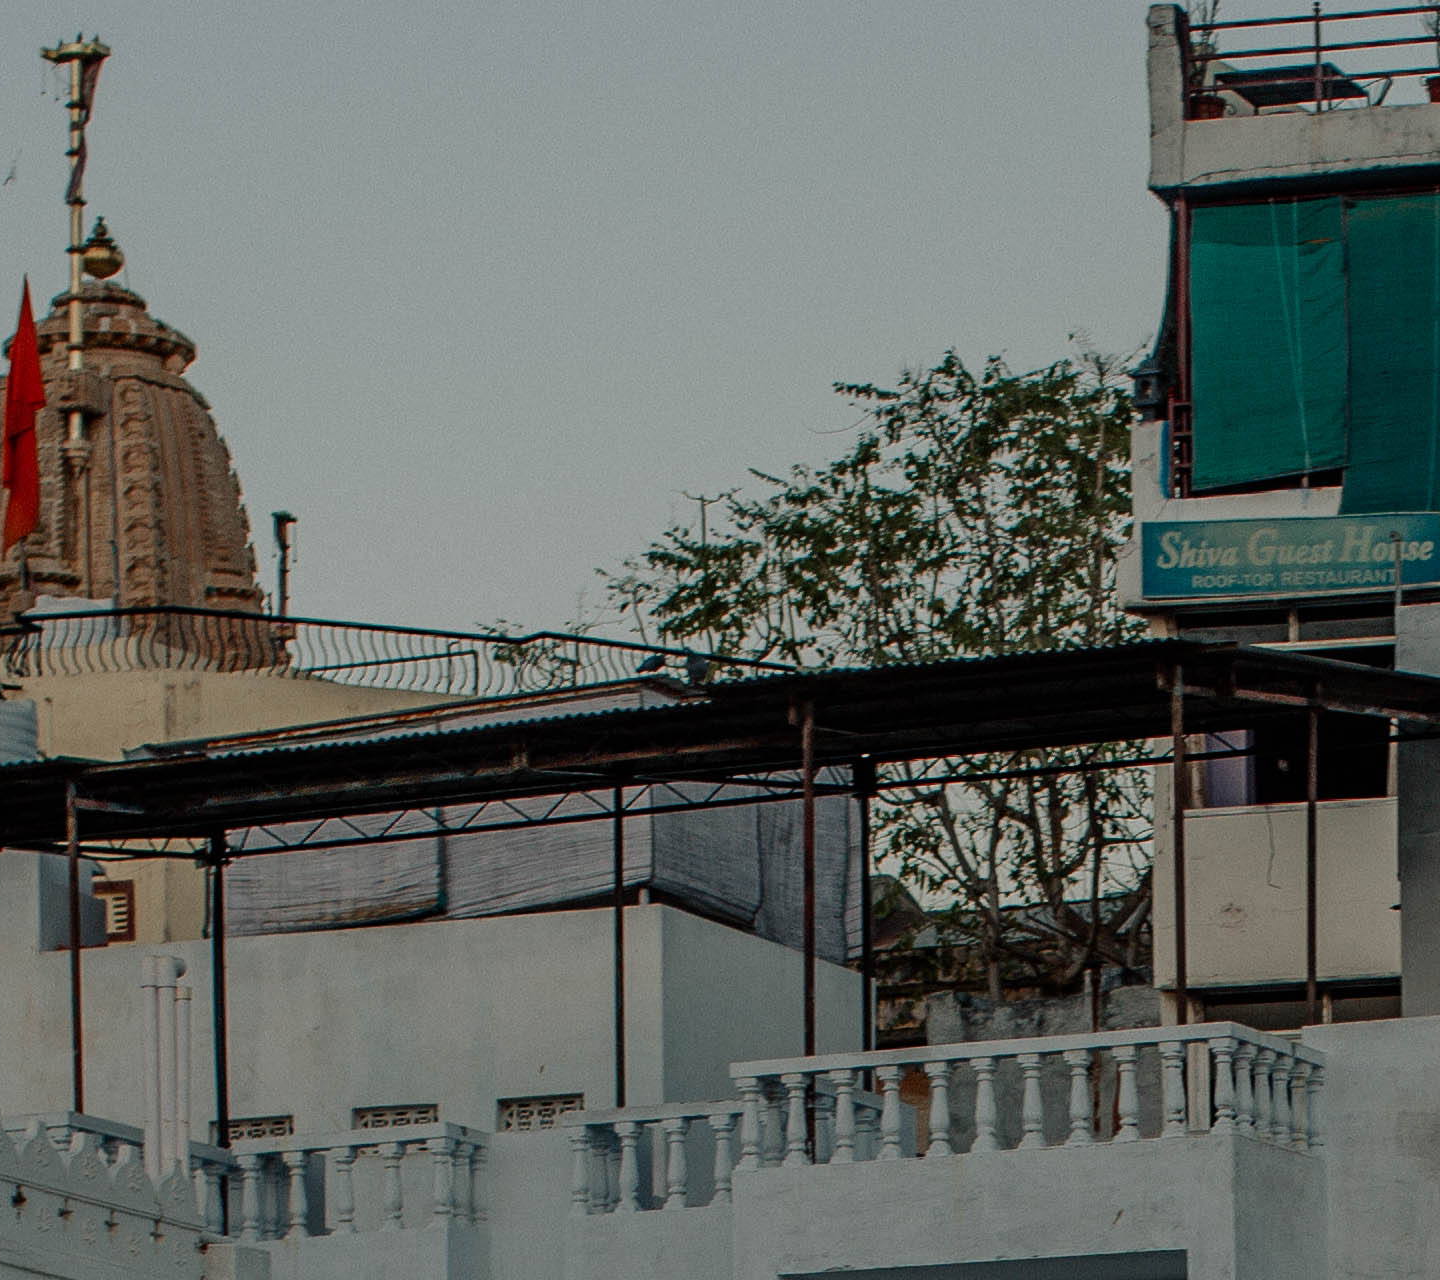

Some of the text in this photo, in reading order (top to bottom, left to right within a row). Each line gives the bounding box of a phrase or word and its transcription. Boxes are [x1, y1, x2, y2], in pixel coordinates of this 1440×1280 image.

[1156, 525, 1435, 569] Shiva Guest House
[1280, 568, 1398, 587] RESTAURANT
